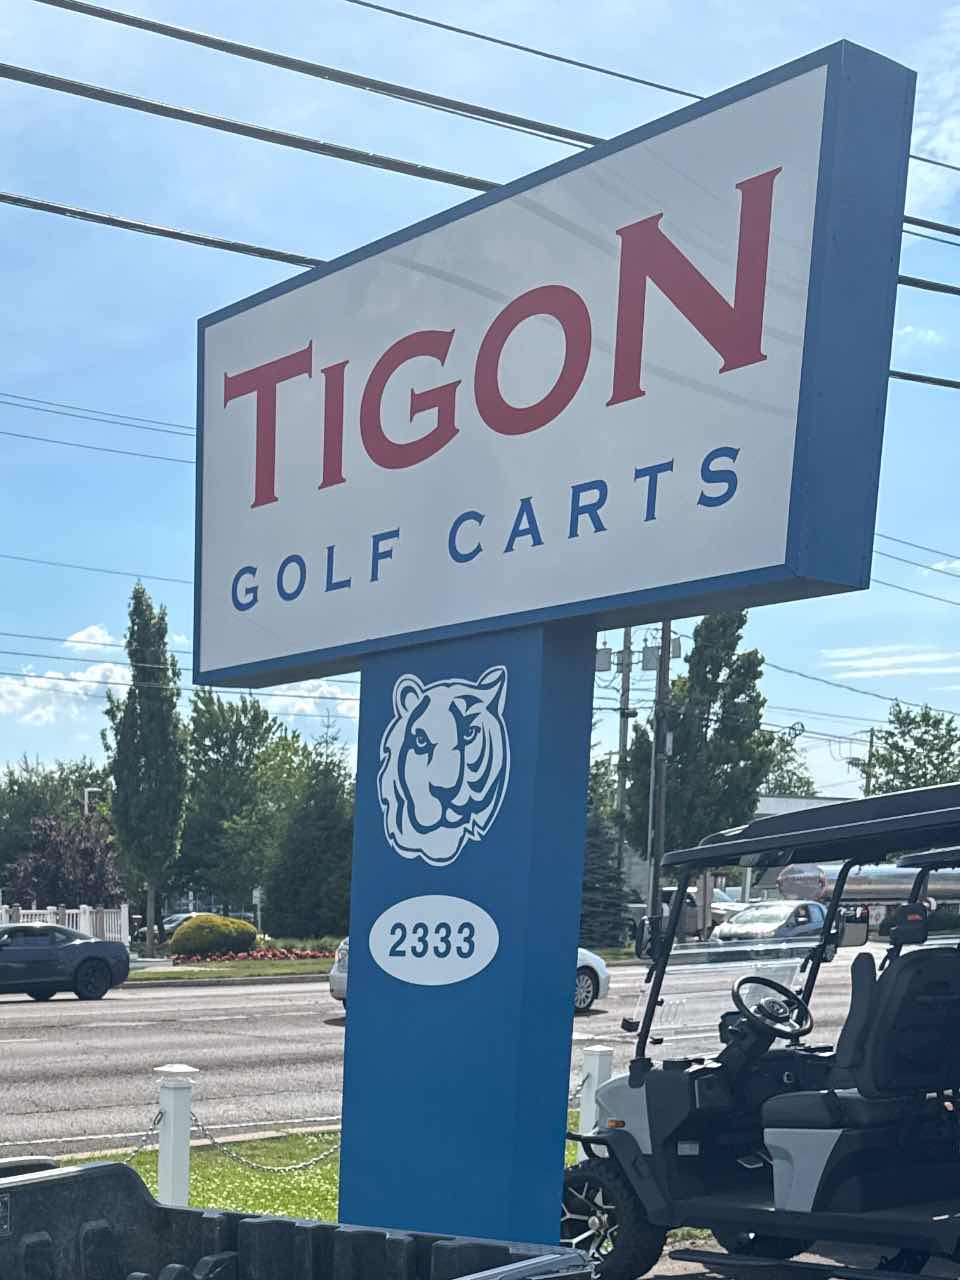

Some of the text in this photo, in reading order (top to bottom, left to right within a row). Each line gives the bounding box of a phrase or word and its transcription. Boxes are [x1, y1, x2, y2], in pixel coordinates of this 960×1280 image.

[224, 166, 783, 510] TIGON
[231, 447, 741, 612] GOLF CARTS
[389, 922, 475, 958] 2333
